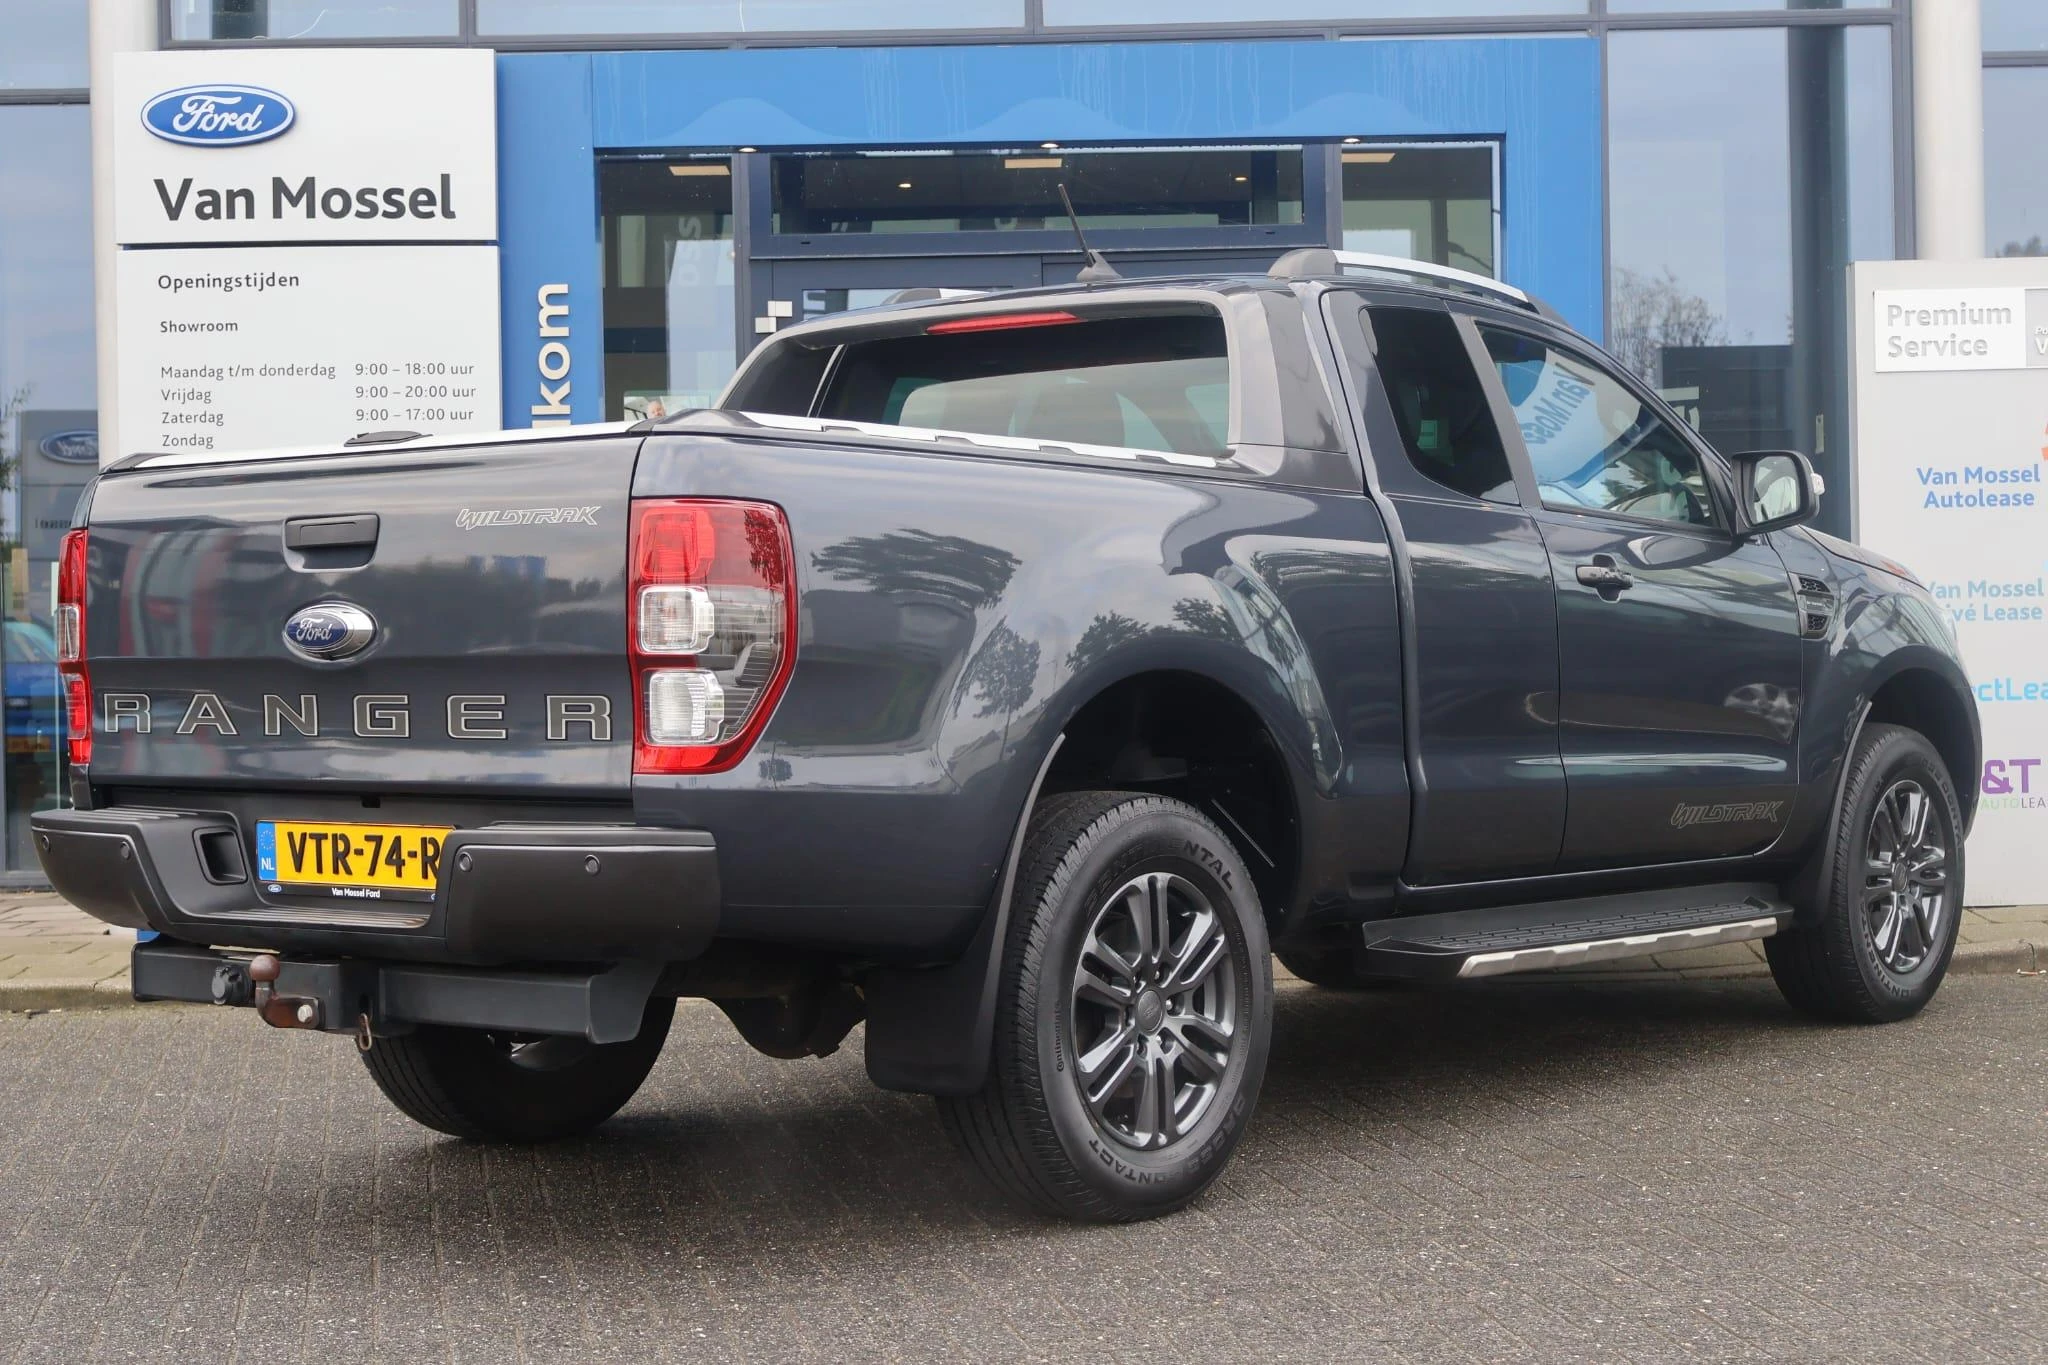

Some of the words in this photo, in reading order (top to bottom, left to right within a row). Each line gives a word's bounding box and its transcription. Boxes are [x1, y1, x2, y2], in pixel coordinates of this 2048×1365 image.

[171, 94, 265, 133] Ford
[153, 176, 255, 221] Van
[271, 173, 457, 220] Mossel
[157, 273, 300, 292] Openingstijden
[1887, 302, 2012, 326] Premium
[159, 319, 239, 334] Showroom
[1887, 334, 1988, 358] Service
[161, 366, 224, 380] Maandag
[227, 365, 254, 378] t/m
[259, 363, 336, 379] donderdag
[355, 363, 388, 375] 9:00
[405, 363, 446, 375] 18:00
[450, 365, 474, 375] uur
[161, 388, 212, 404] Vrijdag
[355, 386, 388, 398] 9:00
[405, 386, 447, 398] 20:00
[452, 388, 476, 398] uur
[162, 410, 224, 427] Zaterdag
[355, 409, 388, 421] 9:00
[406, 409, 445, 420] 17:00
[450, 410, 474, 420] uur
[162, 434, 214, 450] Zondag
[1916, 468, 1957, 485] Van
[1964, 464, 2040, 484] Mossel
[1923, 488, 2035, 509] Autolease
[455, 506, 601, 531] WILDTRAK
[1967, 578, 2044, 598] Mossel
[1983, 604, 2043, 621] Lease
[297, 619, 333, 642] Ford
[103, 693, 612, 741] RANGER
[1671, 800, 1784, 830] WILDTRAK
[261, 858, 275, 871] NL
[287, 831, 441, 880] VTR-74-R
[332, 887, 344, 896] Van
[344, 888, 365, 898] Mossel
[366, 890, 381, 898] Ford
